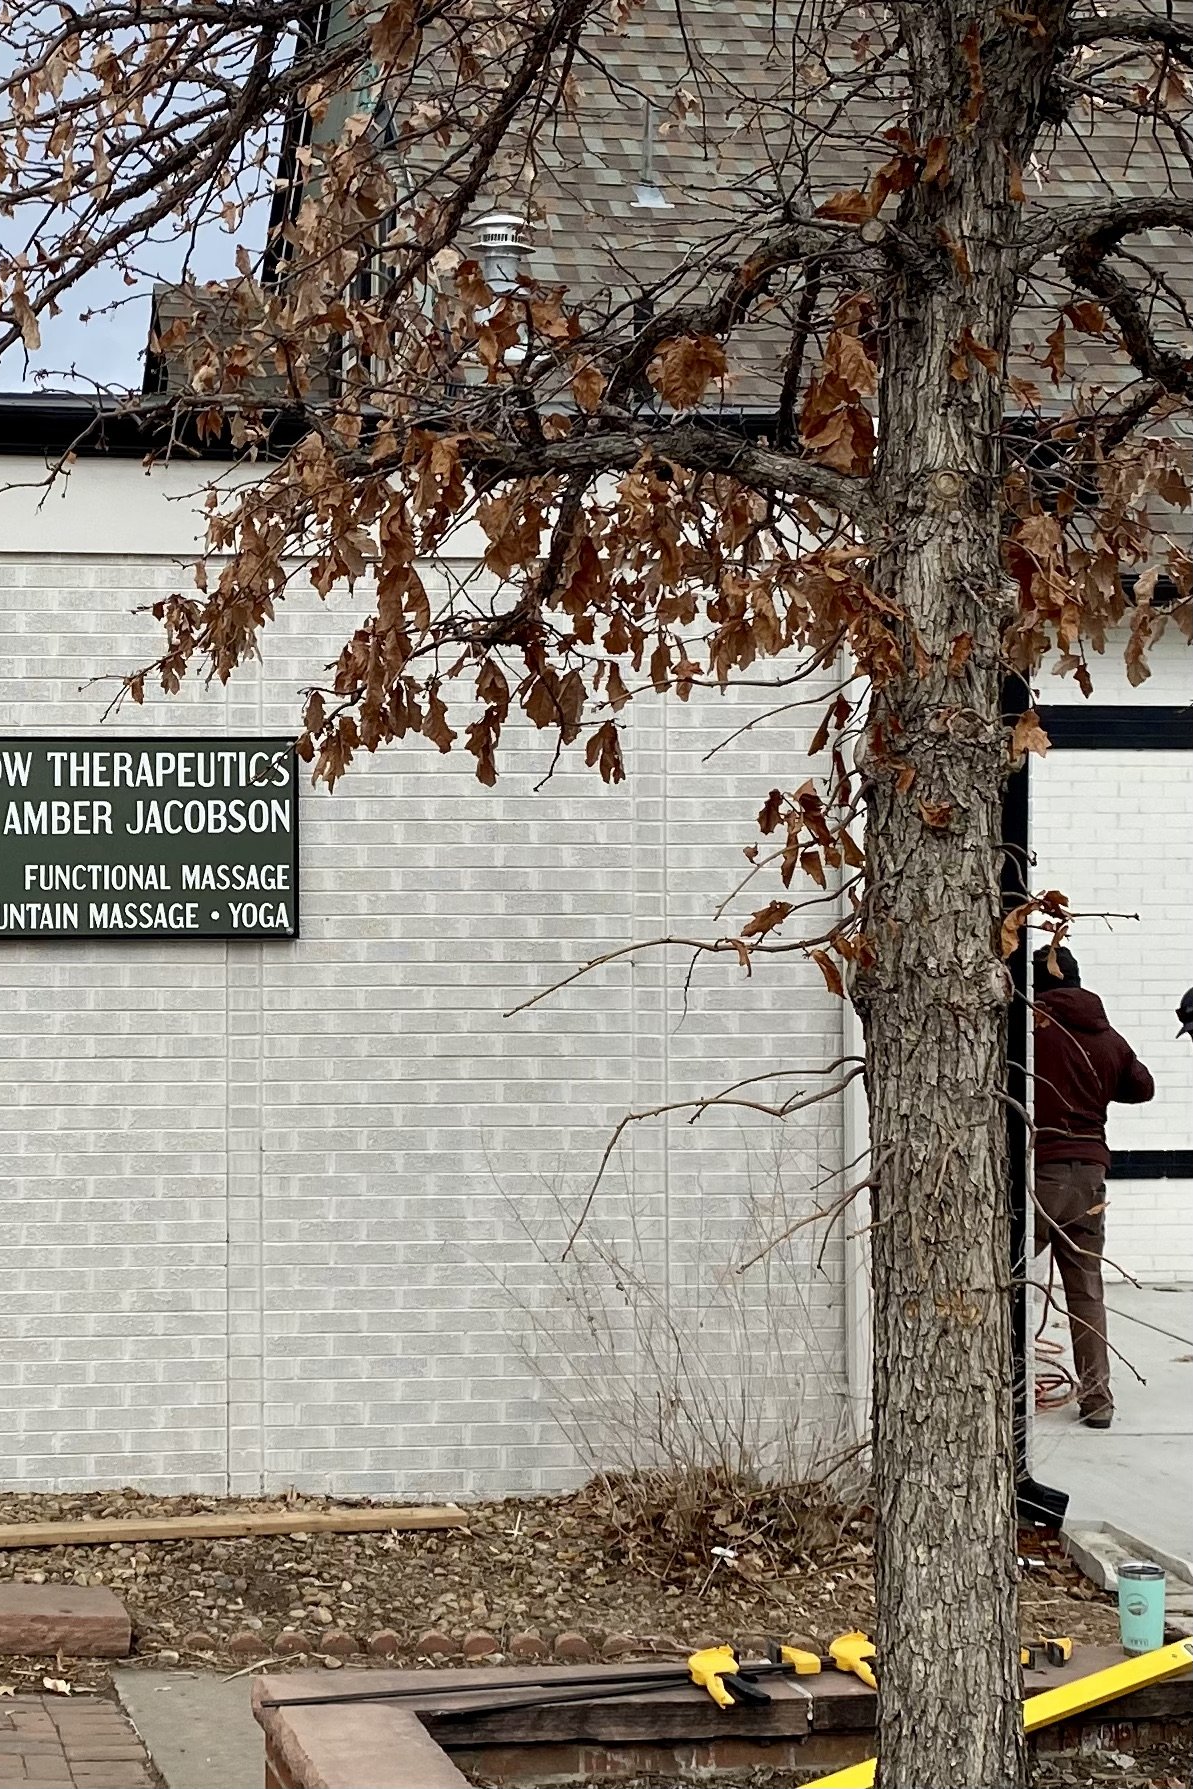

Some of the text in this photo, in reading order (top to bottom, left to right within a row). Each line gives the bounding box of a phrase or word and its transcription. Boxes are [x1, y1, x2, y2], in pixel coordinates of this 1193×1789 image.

[46, 751, 290, 788] THERAPEUTICS
[3, 799, 291, 836] AMBER JACOBSON
[24, 864, 290, 891] FUNCTIONAL MASSAGE
[88, 902, 200, 930] MASSAGE
[227, 902, 291, 929] YOGA
